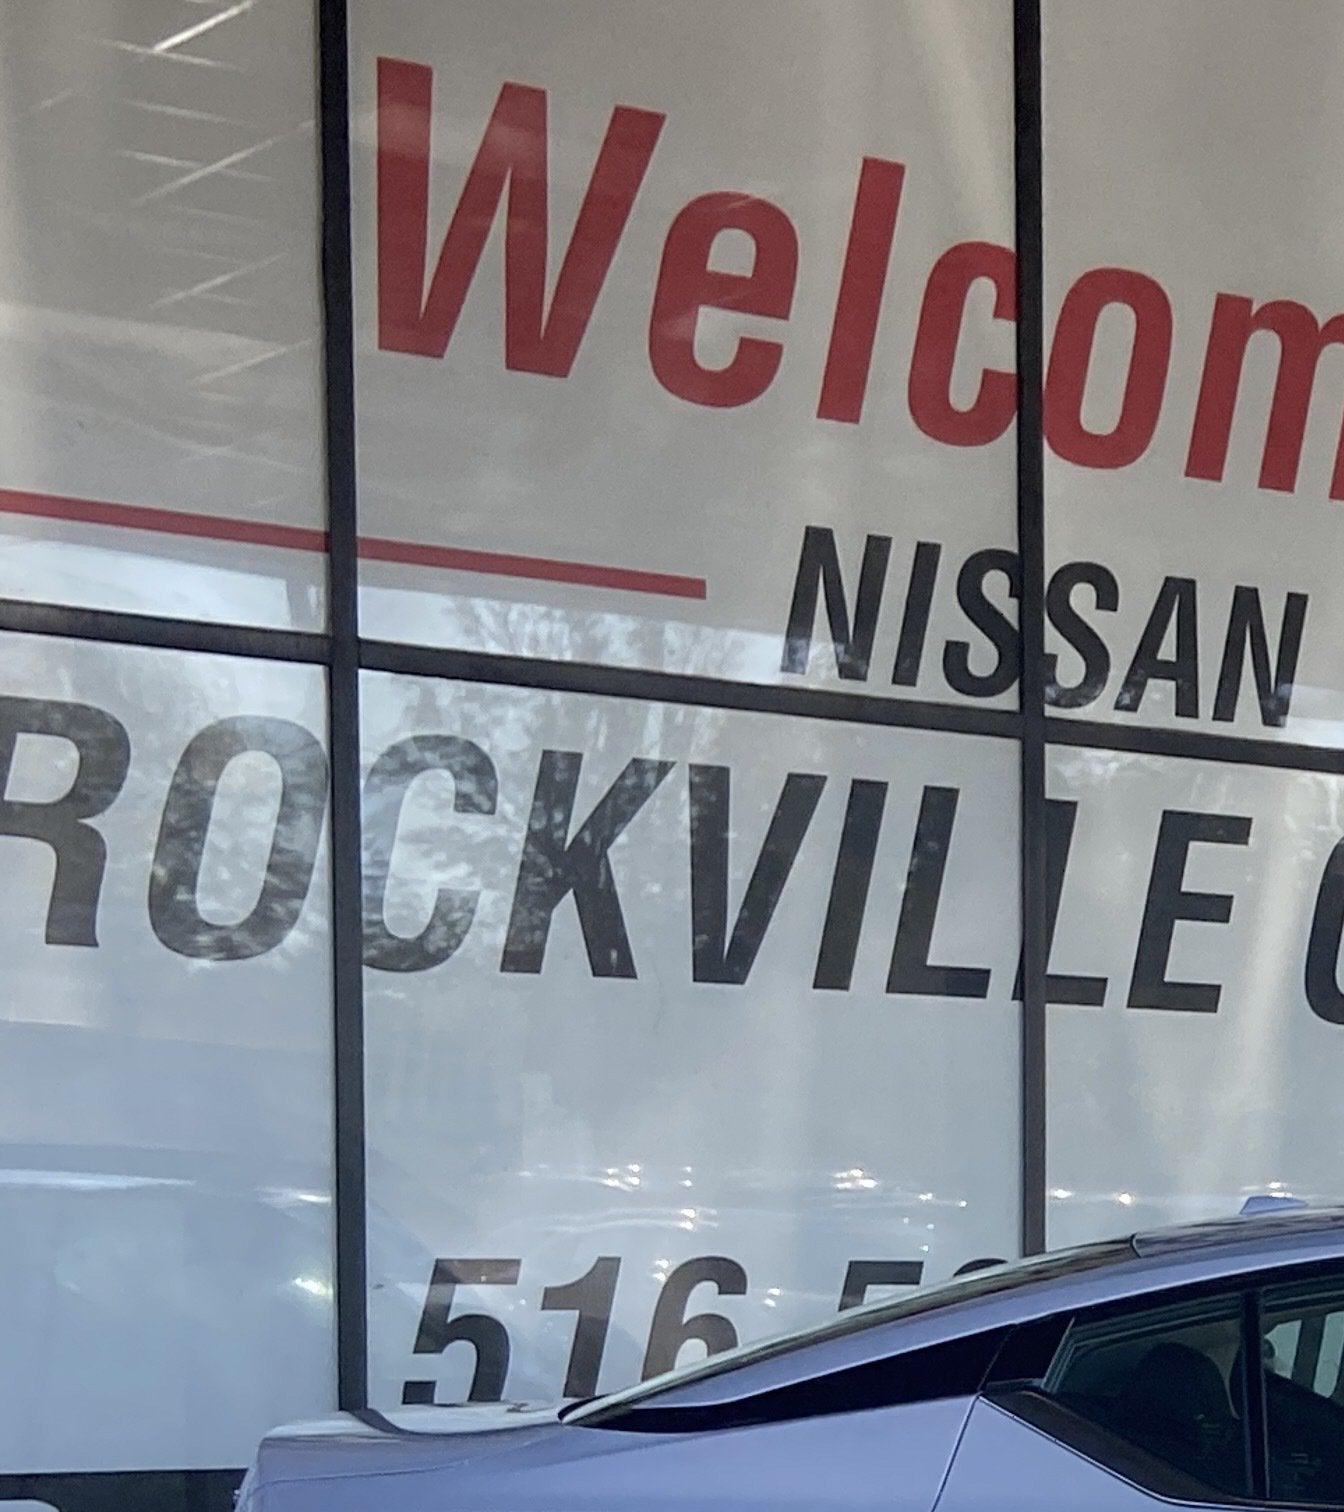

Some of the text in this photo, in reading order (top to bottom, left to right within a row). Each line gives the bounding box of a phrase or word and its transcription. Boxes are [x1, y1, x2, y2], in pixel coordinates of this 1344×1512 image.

[780, 525, 1309, 728] NISSAN
[0, 694, 1253, 1014] ROCKVILLE
[402, 1255, 748, 1406] 516
